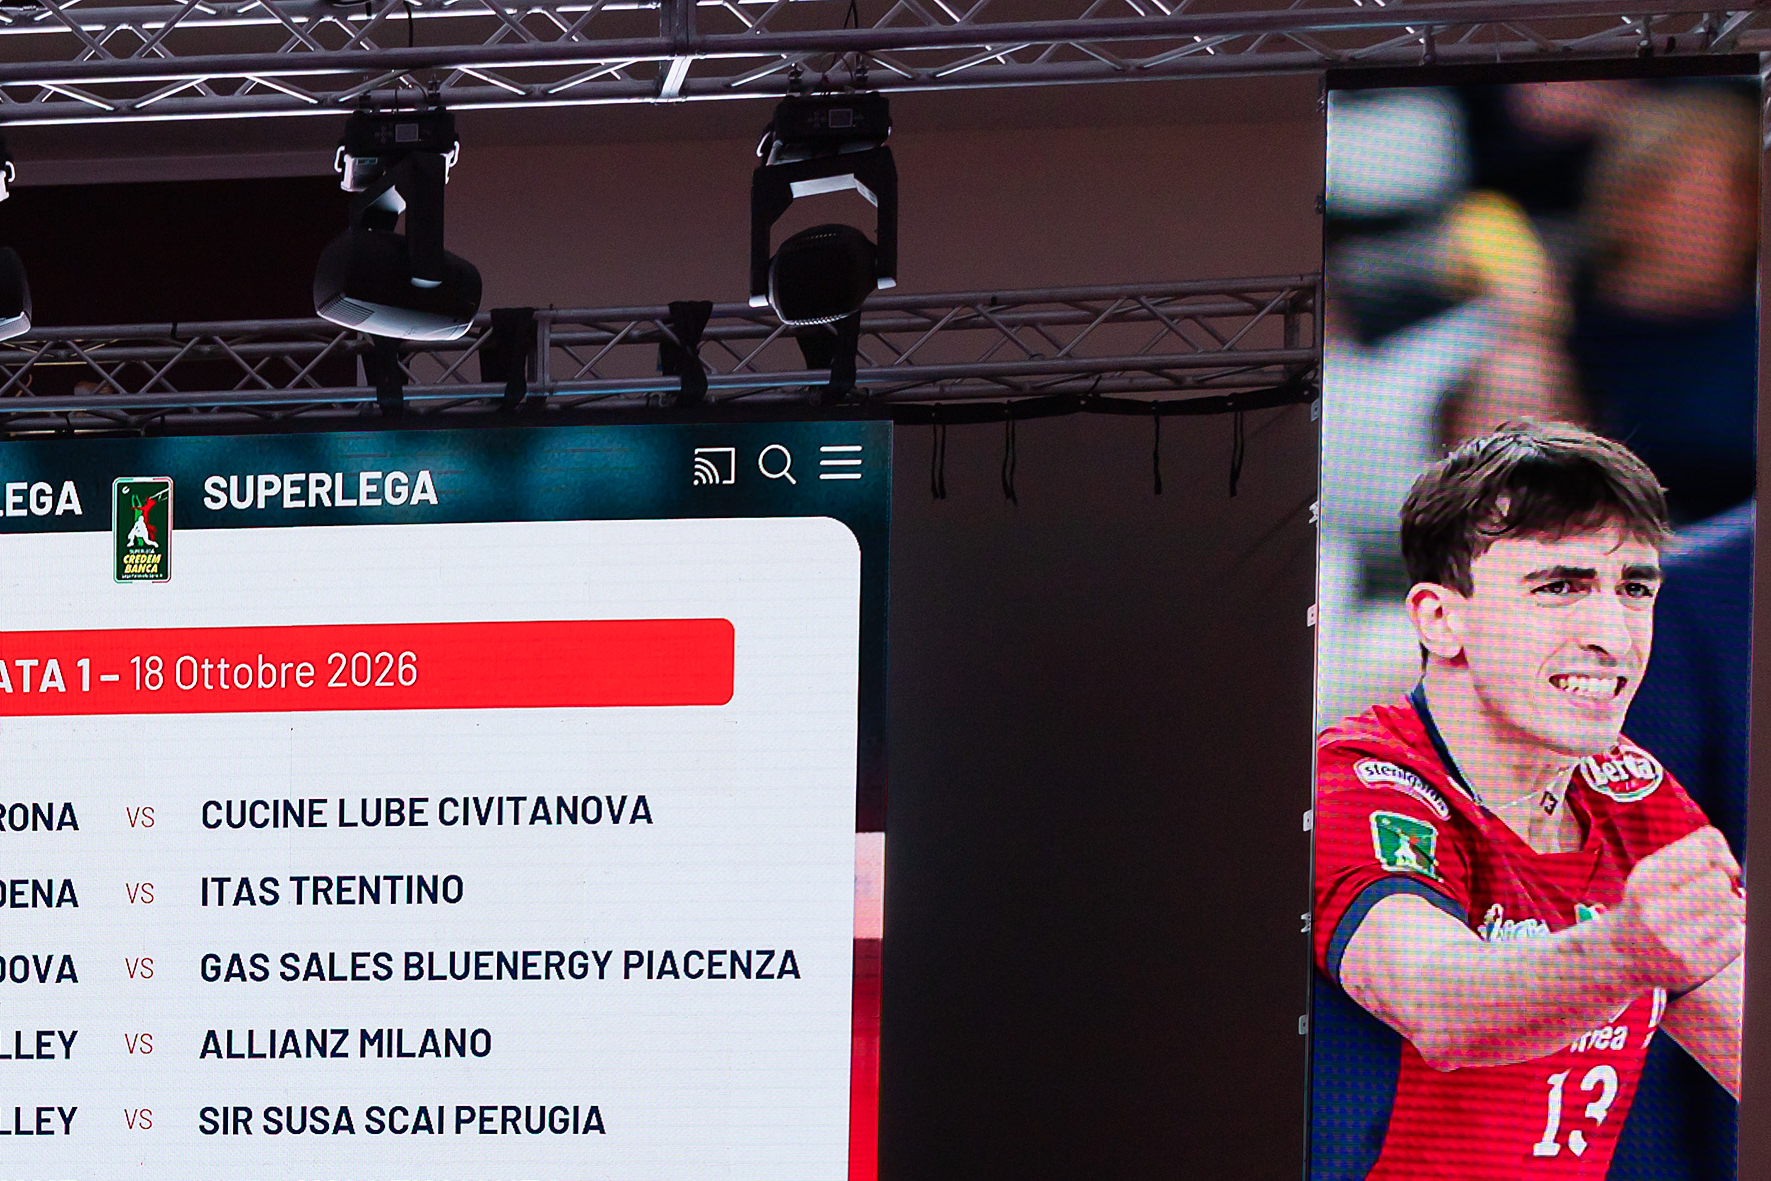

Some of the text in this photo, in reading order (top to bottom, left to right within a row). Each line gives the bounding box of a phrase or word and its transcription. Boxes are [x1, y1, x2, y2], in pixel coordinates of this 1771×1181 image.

[204, 471, 438, 509] SUPERLEGA
[123, 554, 162, 564] CREDEM
[124, 564, 158, 573] BANCA
[78, 659, 90, 691] 1
[131, 656, 163, 690] 18
[176, 654, 314, 689] Ottobre
[328, 652, 417, 687] 2026
[126, 807, 154, 828] VS
[202, 795, 653, 829] CUCINE LUBE CIVITANOVA
[126, 883, 154, 904] VS
[202, 875, 463, 906] ITAS TRENTINO
[125, 957, 153, 979] VS
[201, 950, 800, 982] GAS SALES BLUENERGY PIACENZA
[125, 1033, 153, 1054] VS
[200, 1028, 491, 1059] ALLIANZ MILANO
[124, 1109, 152, 1129] VS
[199, 1106, 606, 1135] SIR SUSA SCAI PERUGIA
